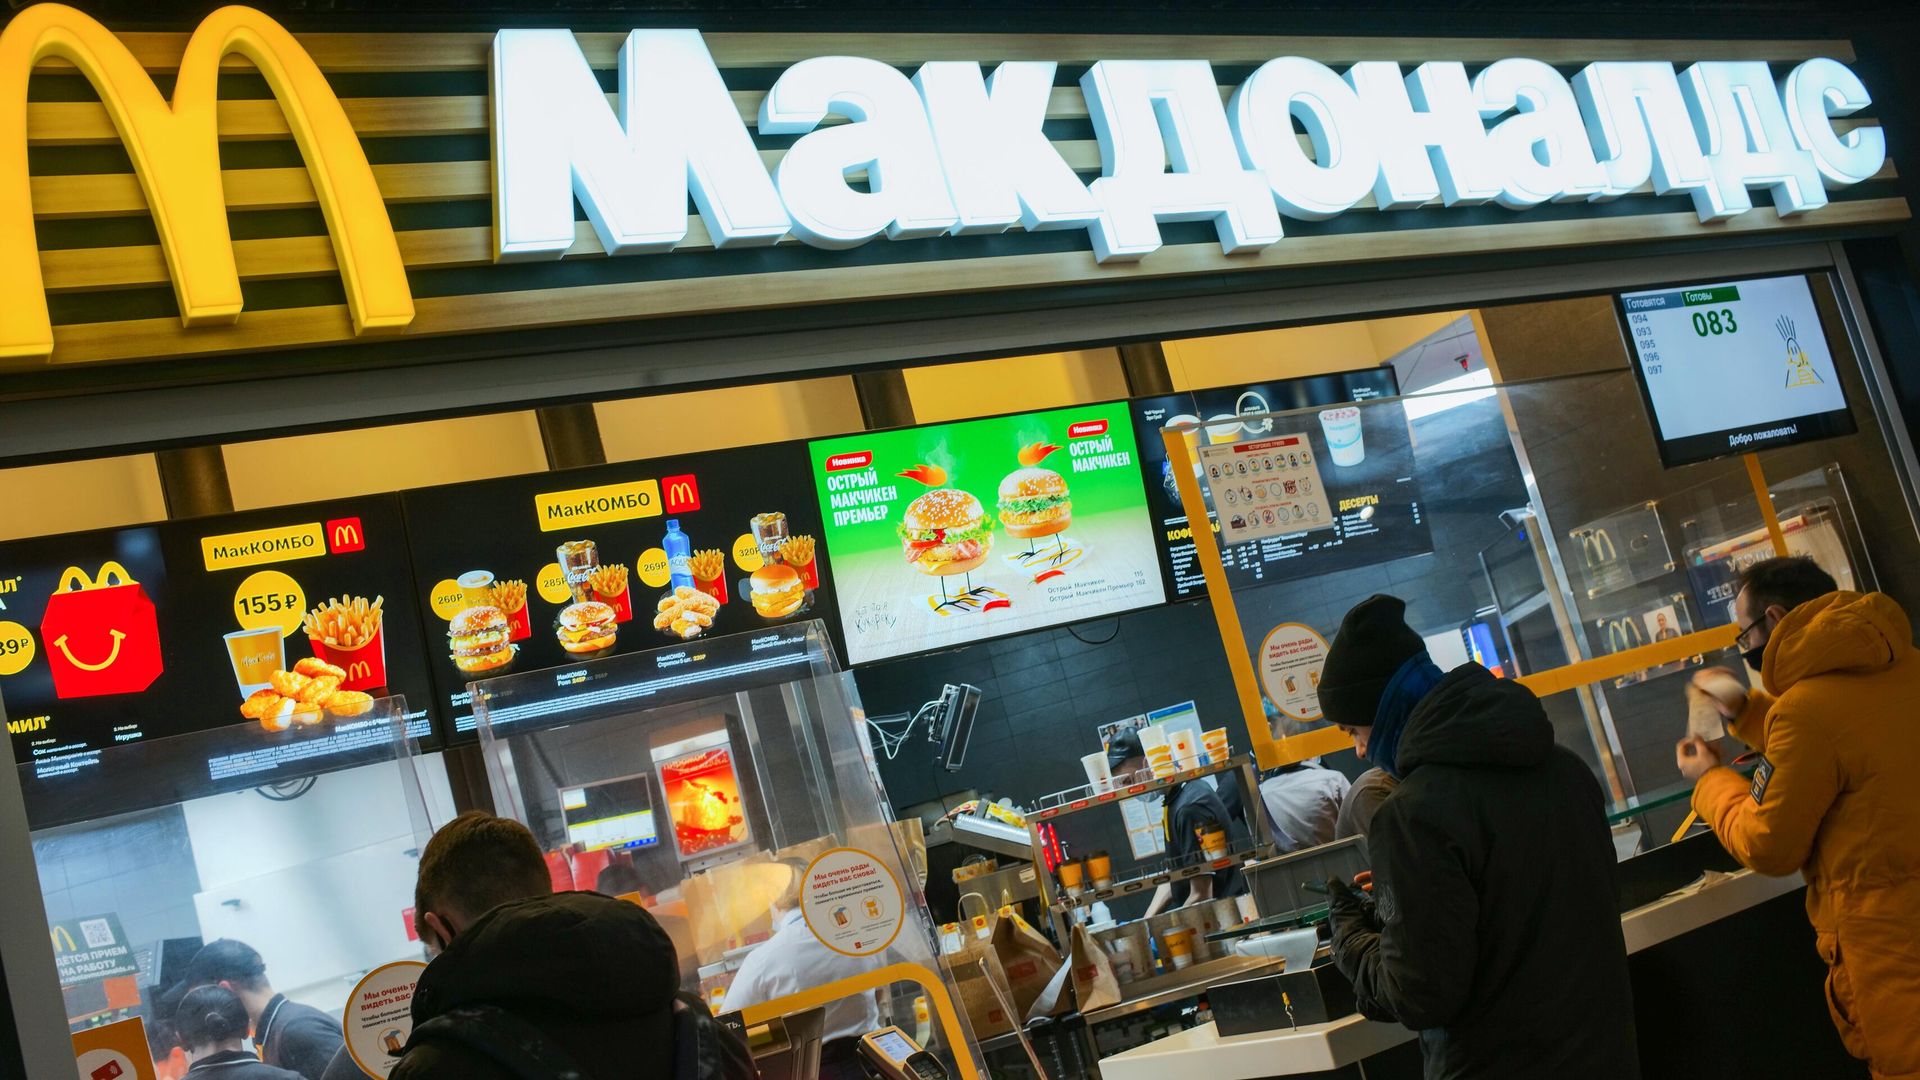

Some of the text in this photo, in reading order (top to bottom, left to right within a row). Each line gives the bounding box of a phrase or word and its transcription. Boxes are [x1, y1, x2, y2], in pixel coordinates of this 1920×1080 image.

[490, 28, 1886, 264] Макдоналдс
[1626, 297, 1666, 309] Готовятся
[1685, 292, 1713, 303] Готовы
[1632, 314, 1648, 324] 094
[1692, 308, 1738, 337] 083
[1636, 327, 1652, 337] 093
[1640, 340, 1656, 349] 095
[1643, 352, 1660, 362] 096
[1647, 365, 1662, 375] 097
[1729, 424, 1798, 447] Добро пожаловать!
[1069, 434, 1114, 457] ОСТРЫЙ
[832, 456, 867, 467] Новинка
[1072, 451, 1131, 473] МАКЧИКЕН
[827, 466, 879, 492] ОСТРЫЙ
[548, 492, 650, 519] МакКОМБО
[830, 485, 898, 510] МАКЧИКЕН
[1339, 494, 1379, 512] ДЕСЕРТЫ
[833, 504, 889, 527] ПРЕМЬЕР
[213, 534, 315, 560] МакКОМБО
[115, 731, 143, 742] Игрушка
[812, 880, 838, 890] видеть
[854, 868, 877, 879] снова!
[814, 863, 870, 881] Мы очень рады
[60, 959, 116, 977] НА РАБОТУ
[361, 993, 411, 1011] видеть вас
[364, 991, 379, 1001] Мы
[381, 985, 409, 997] очень
